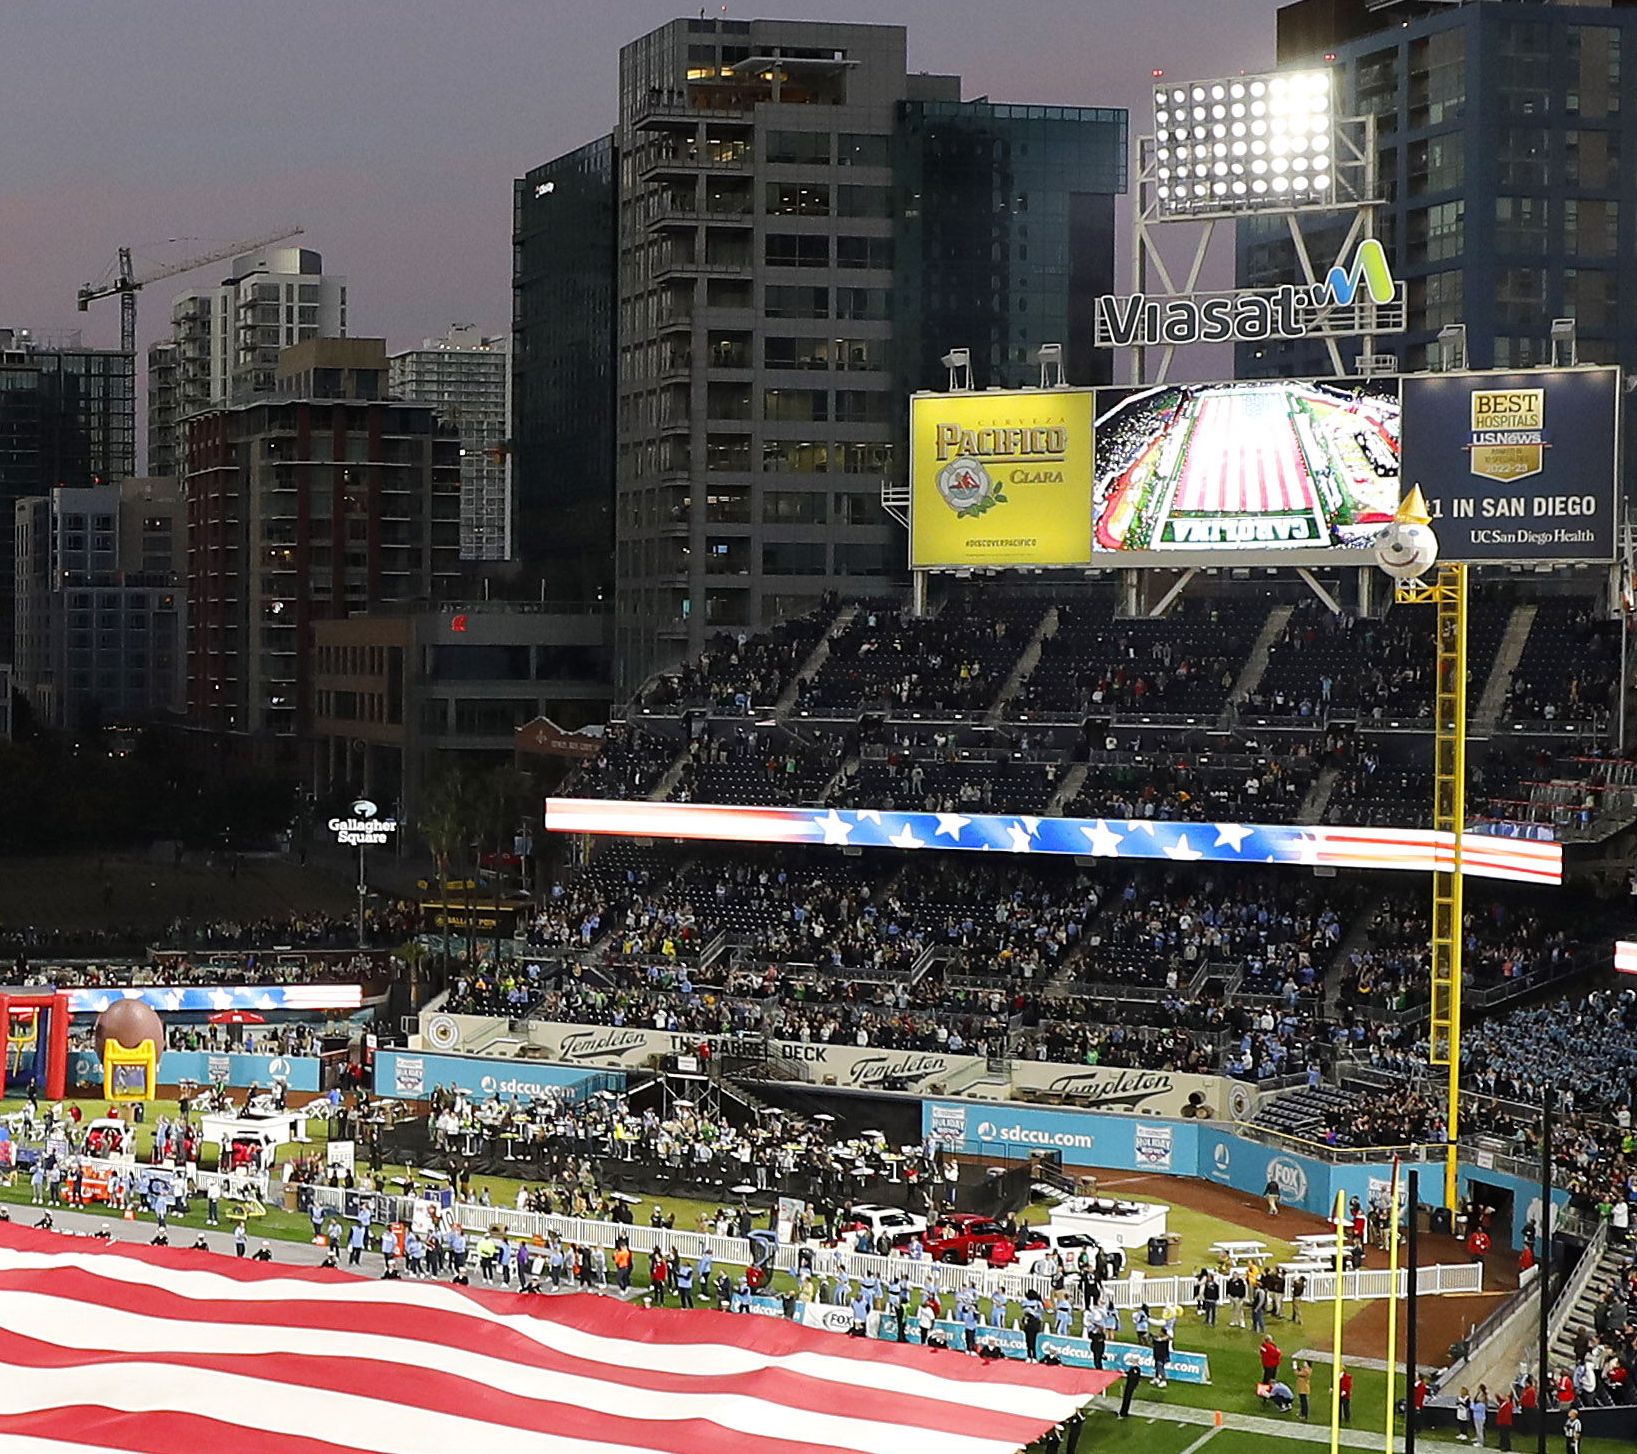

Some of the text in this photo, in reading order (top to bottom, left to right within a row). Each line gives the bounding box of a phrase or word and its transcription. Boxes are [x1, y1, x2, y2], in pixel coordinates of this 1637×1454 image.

[1100, 285, 1305, 347] Viasat
[1477, 393, 1538, 413] BEST
[977, 417, 1066, 427] CERVEZA
[1476, 413, 1538, 429] HOSPITALS
[1008, 467, 1065, 484] CLARA
[1485, 463, 1529, 473] 2022-23
[1452, 498, 1478, 518] IN
[1481, 497, 1530, 517] SAN
[1533, 496, 1596, 516] DIEGO
[1171, 517, 1310, 542] CAROLINA
[1470, 529, 1594, 545] UC San Diego Health
[328, 818, 396, 834] Gallagher
[337, 831, 387, 845] Square
[559, 1030, 647, 1058] Templeton
[781, 1042, 827, 1063] DECK
[850, 1055, 947, 1085] Templeton
[999, 1124, 1093, 1148] sdccu.com
[1275, 1163, 1298, 1188] FOX
[831, 1313, 853, 1326] FOX
